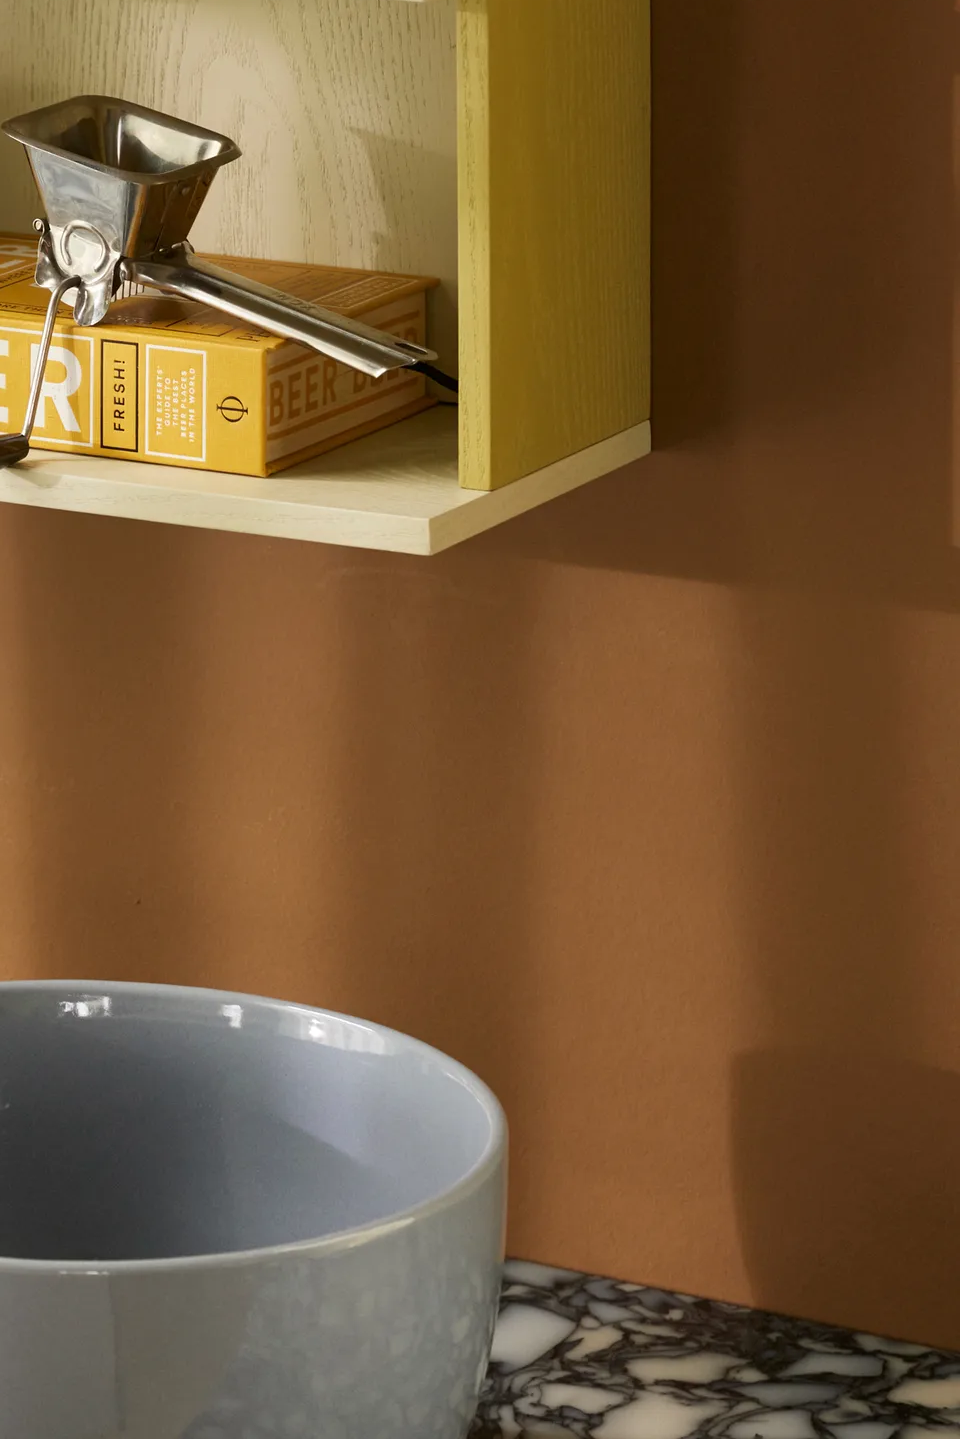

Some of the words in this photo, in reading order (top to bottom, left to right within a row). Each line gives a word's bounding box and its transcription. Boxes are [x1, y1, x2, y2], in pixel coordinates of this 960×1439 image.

[113, 359, 126, 432] FRESH!
[164, 377, 171, 391] TO
[269, 360, 338, 427] BEER
[189, 431, 195, 443] IN
